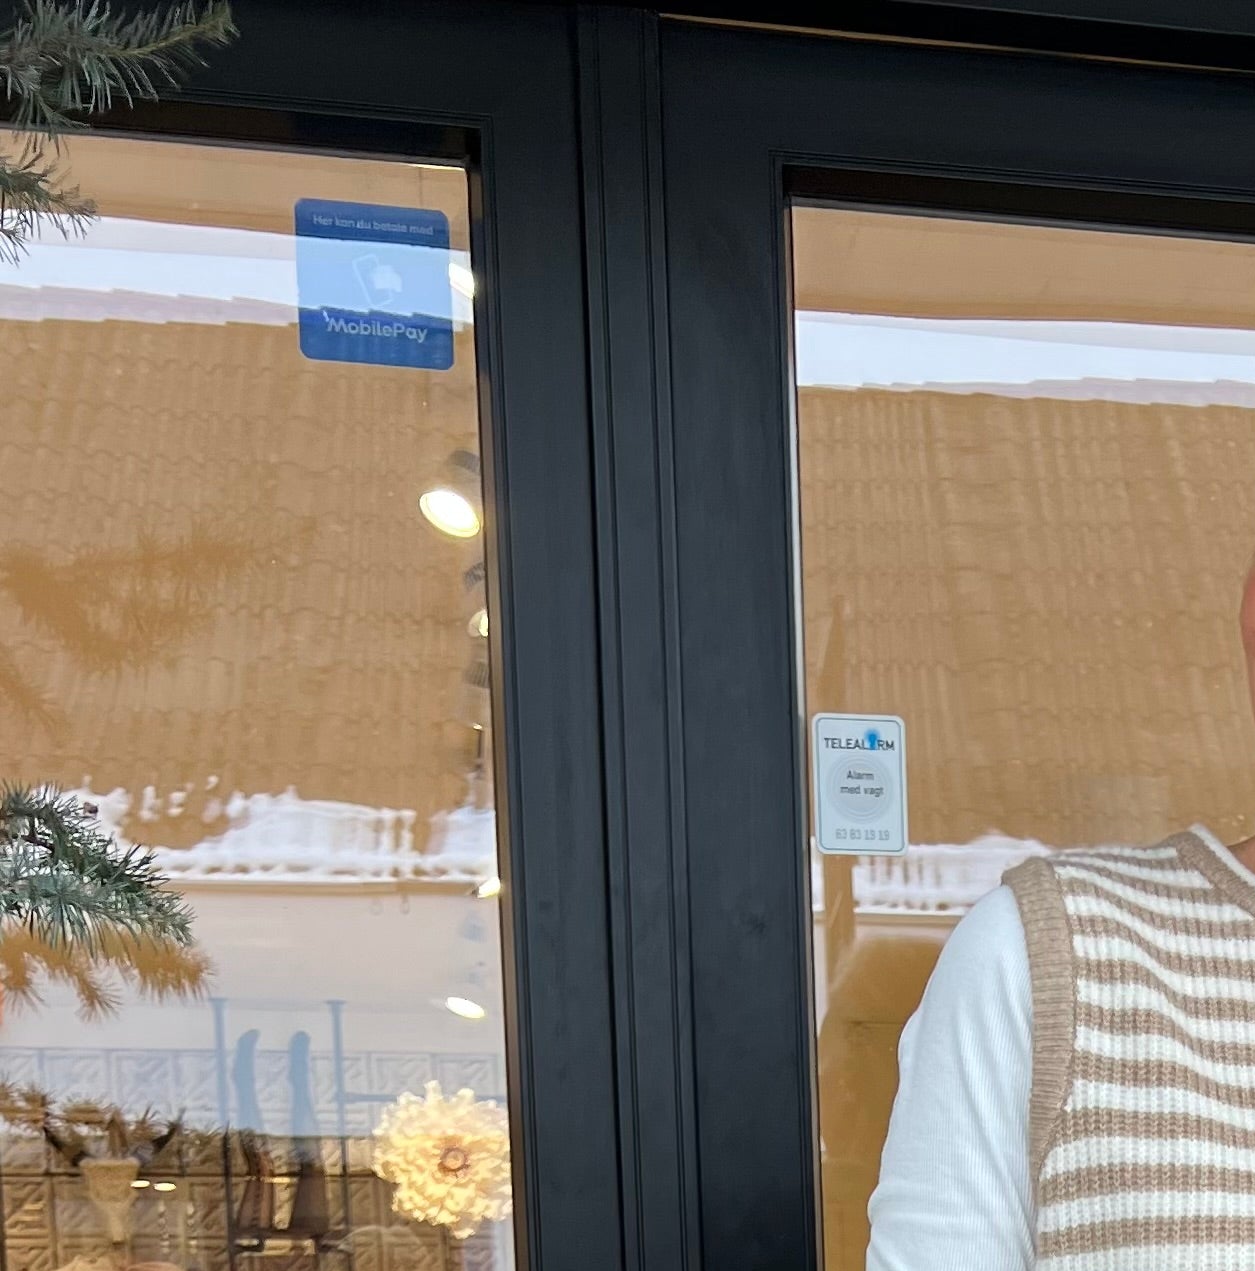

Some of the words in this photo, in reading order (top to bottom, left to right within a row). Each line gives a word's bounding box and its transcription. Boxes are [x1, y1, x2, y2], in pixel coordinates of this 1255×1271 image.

[357, 218, 371, 229] du
[327, 316, 428, 343] MobilePay
[847, 770, 874, 780] Alarm
[840, 785, 861, 795] med
[864, 786, 884, 797] vagt
